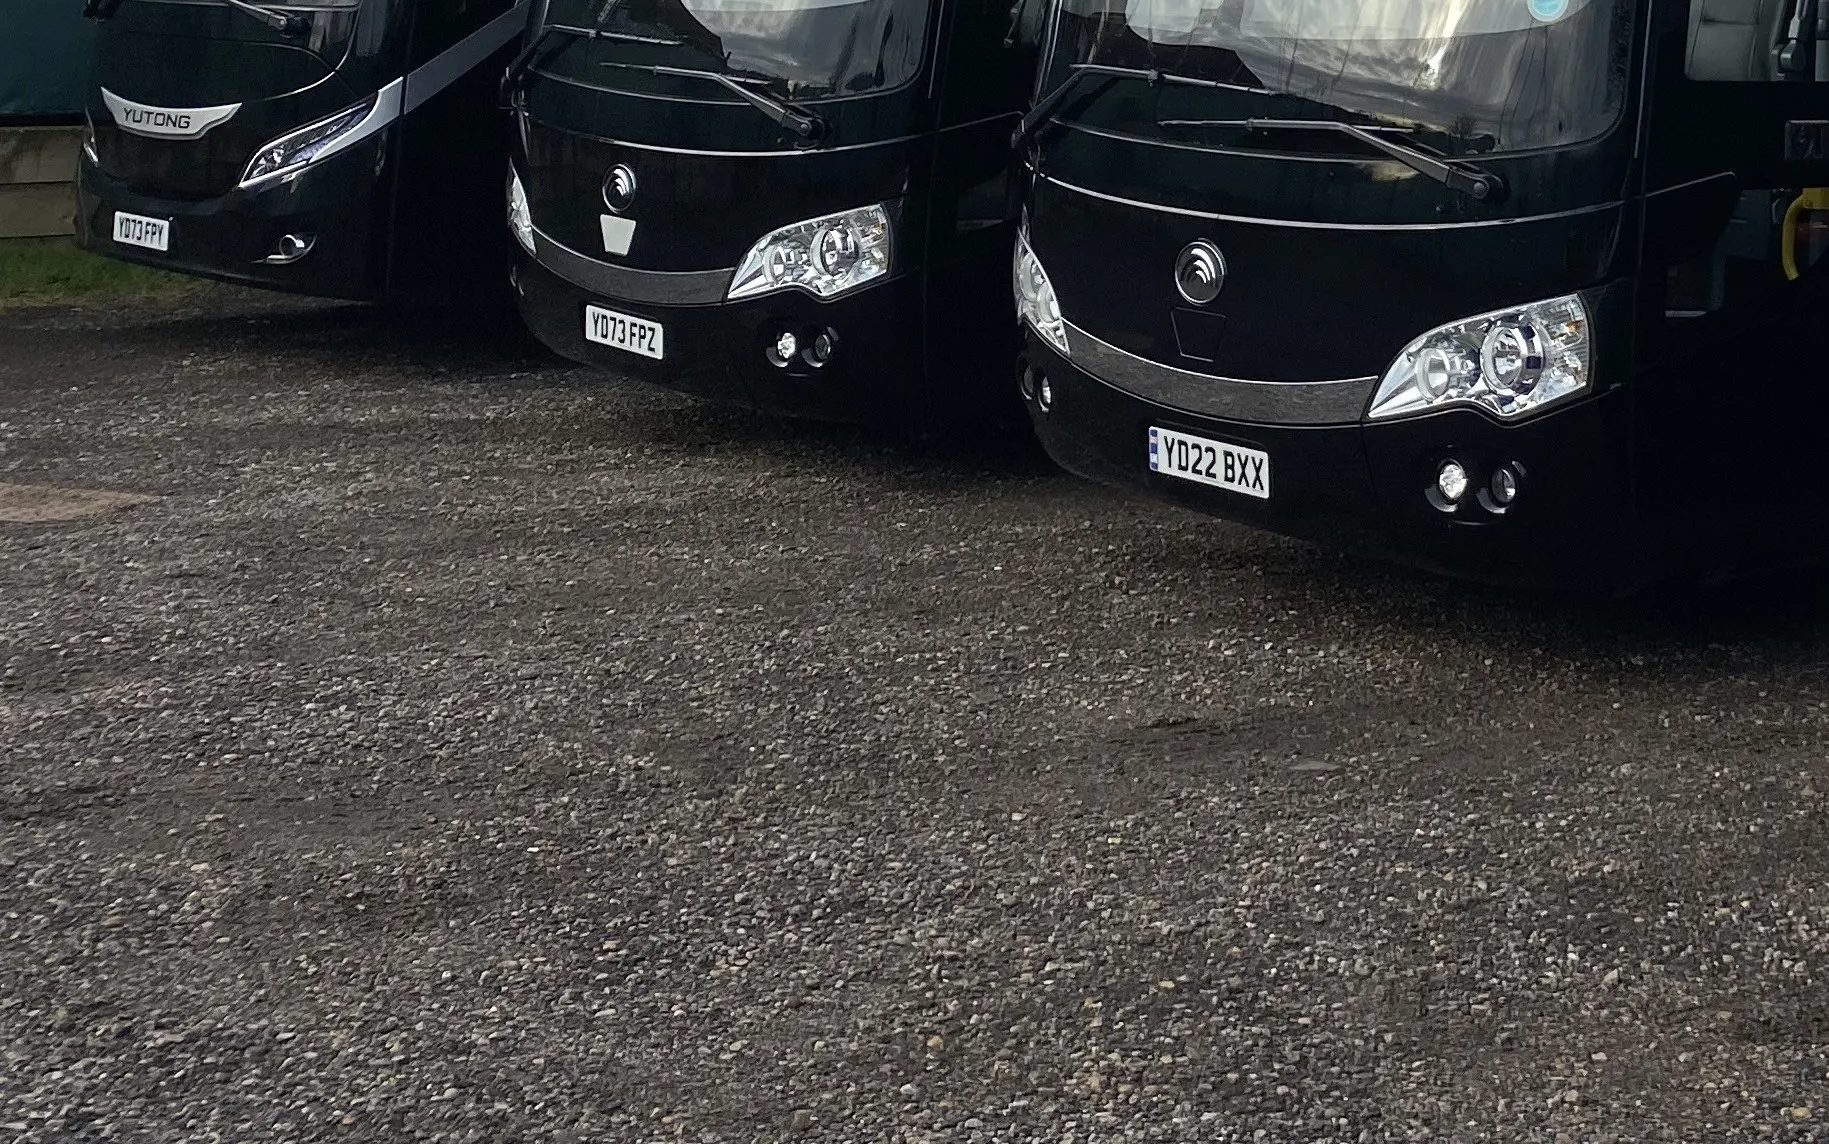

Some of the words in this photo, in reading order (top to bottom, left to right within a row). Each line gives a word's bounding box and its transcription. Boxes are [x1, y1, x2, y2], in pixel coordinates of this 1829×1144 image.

[123, 107, 191, 129] YUTONG
[592, 311, 626, 344] YD73
[629, 321, 656, 353] FPZ
[1164, 435, 1217, 480] YD22
[1223, 449, 1265, 491] BXX
